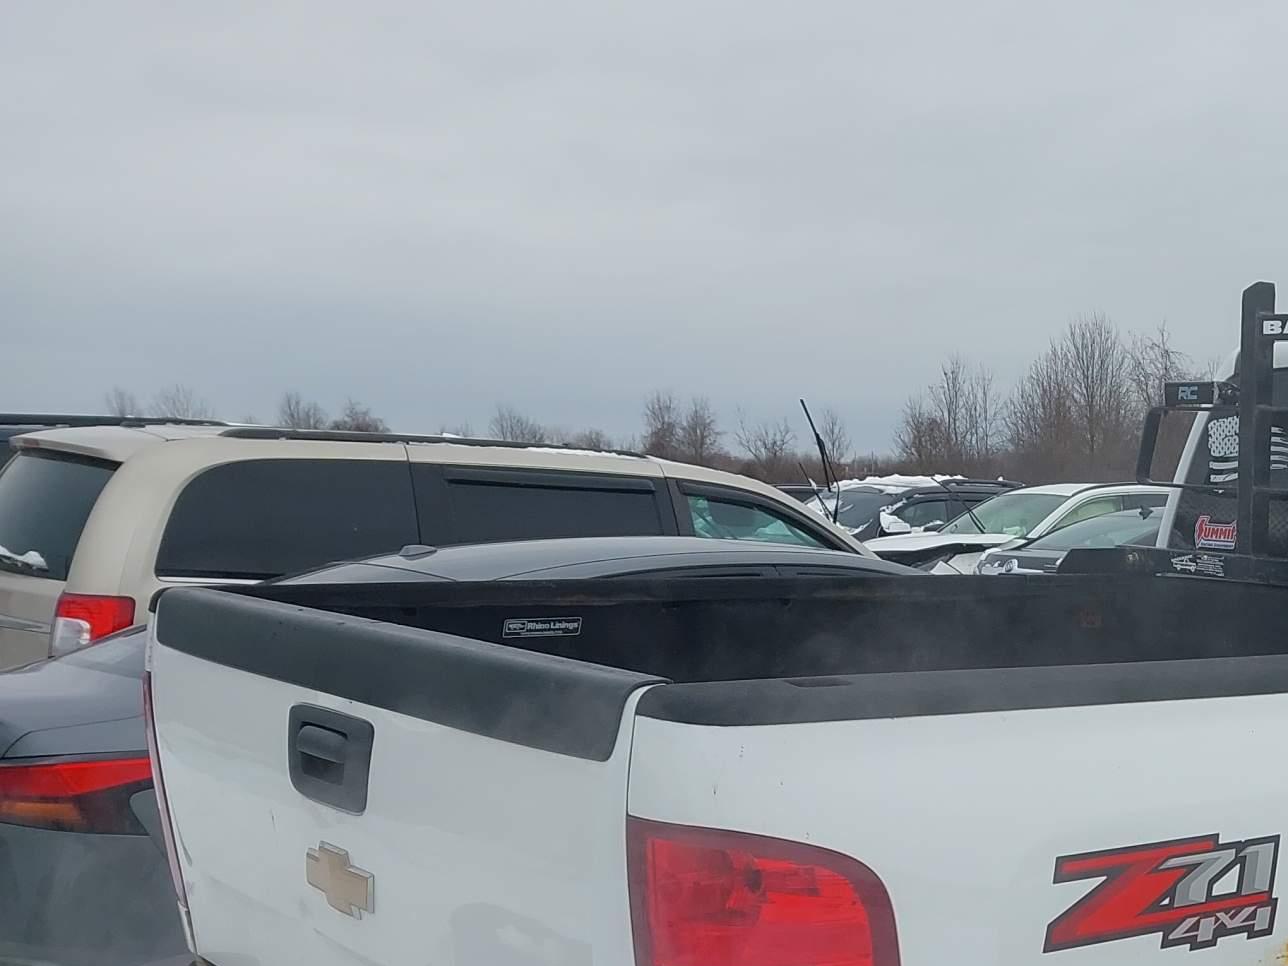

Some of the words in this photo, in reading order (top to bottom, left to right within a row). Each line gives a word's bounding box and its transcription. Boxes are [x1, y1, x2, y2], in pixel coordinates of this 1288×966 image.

[1178, 385, 1199, 400] RC
[527, 621, 550, 630] Rhino
[550, 620, 579, 630] Linings
[1044, 834, 1279, 951] Z71
